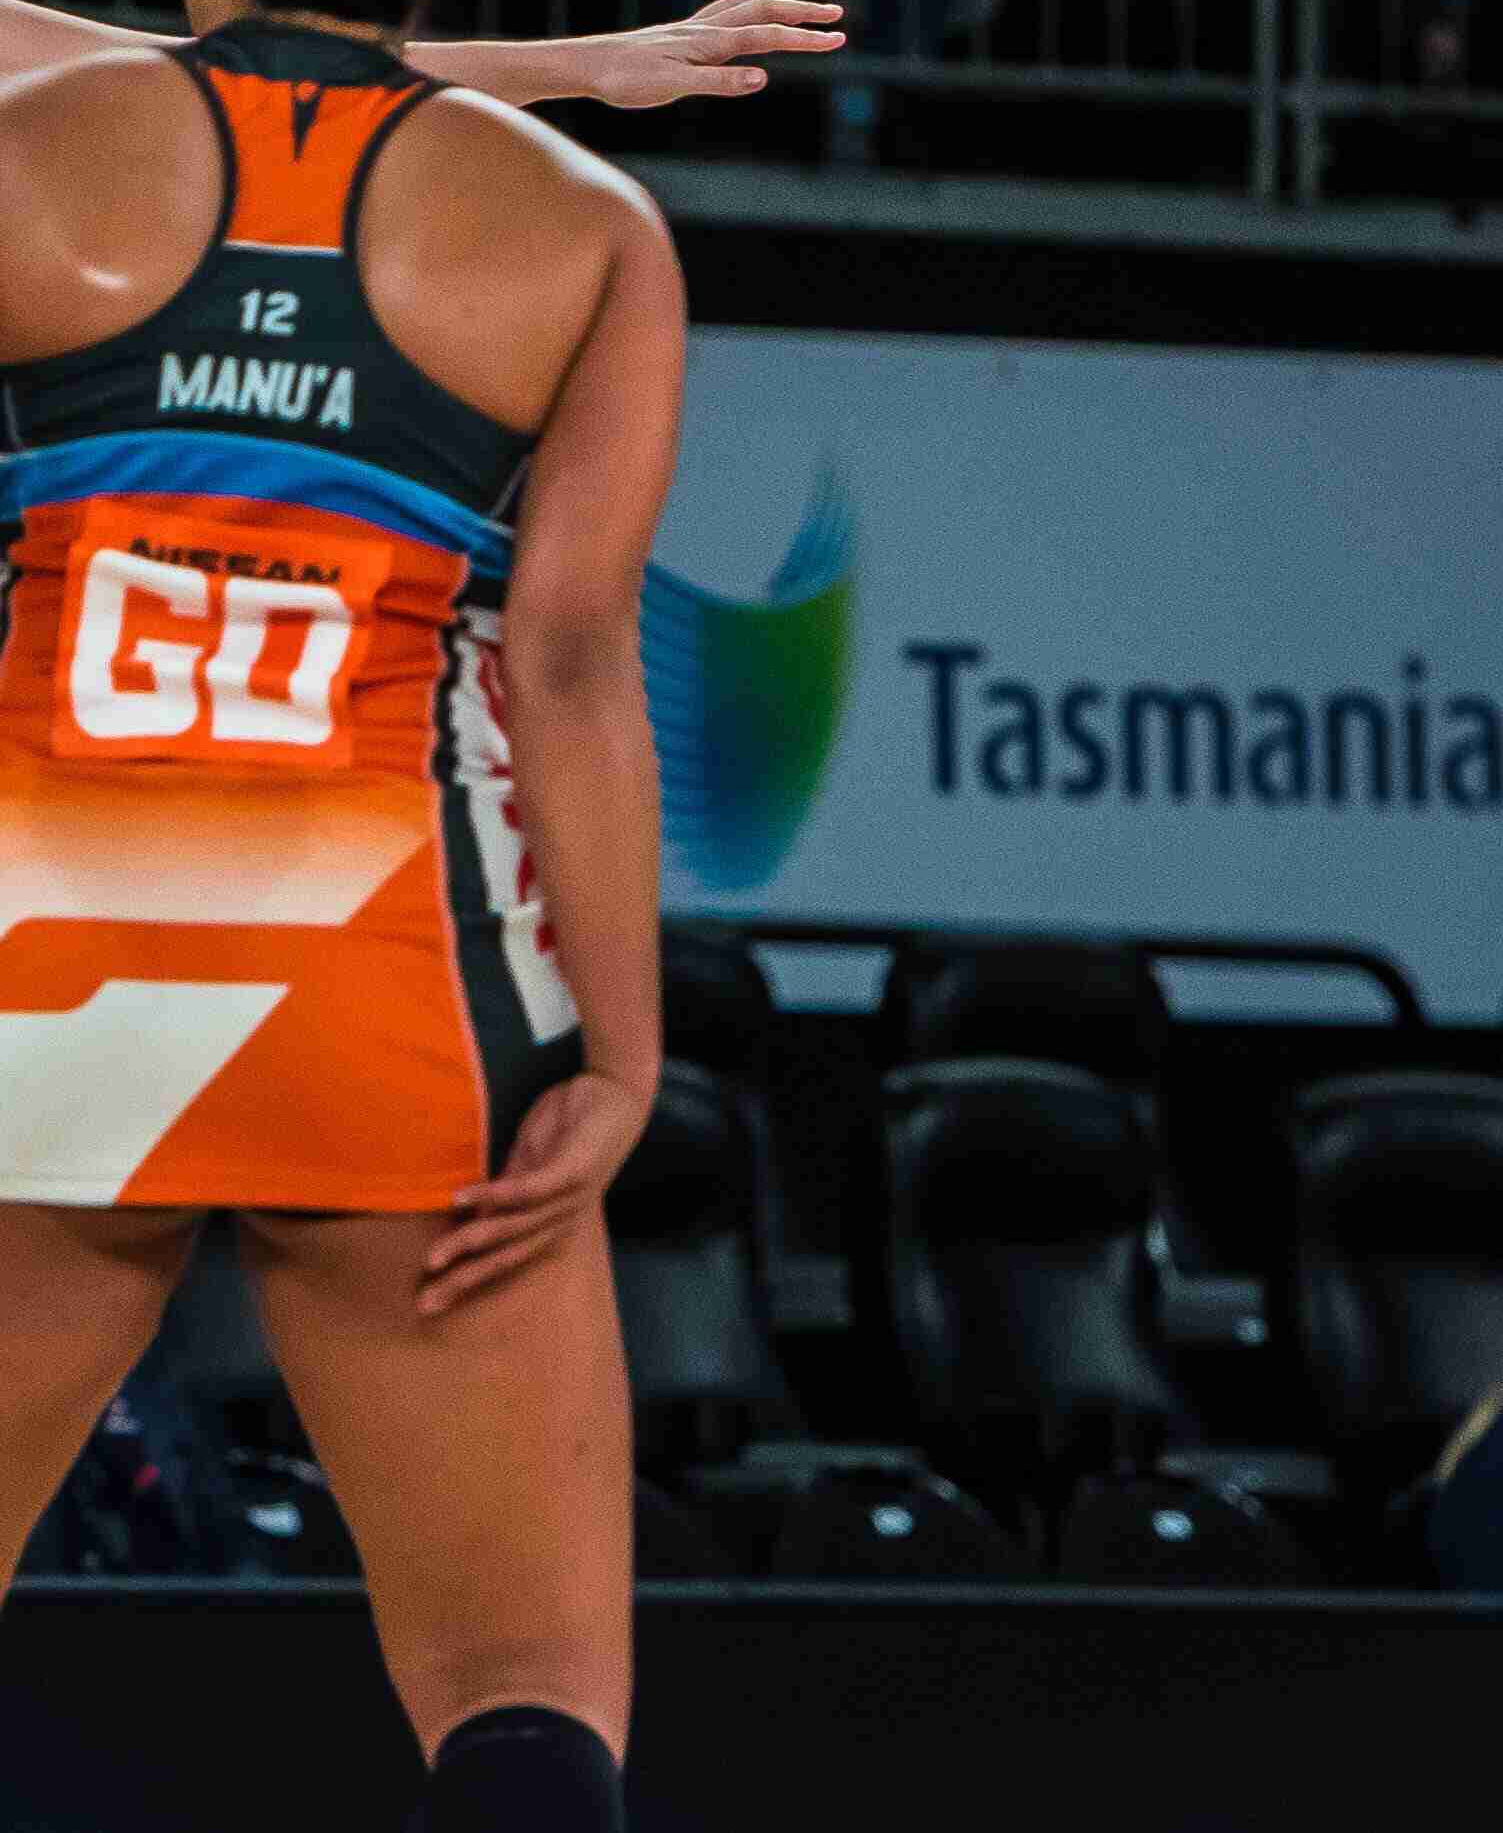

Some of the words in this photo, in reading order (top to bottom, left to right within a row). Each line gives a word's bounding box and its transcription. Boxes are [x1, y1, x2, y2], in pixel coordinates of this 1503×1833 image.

[239, 288, 300, 336] 12
[158, 353, 355, 429] MANU'A
[69, 548, 353, 747] GD
